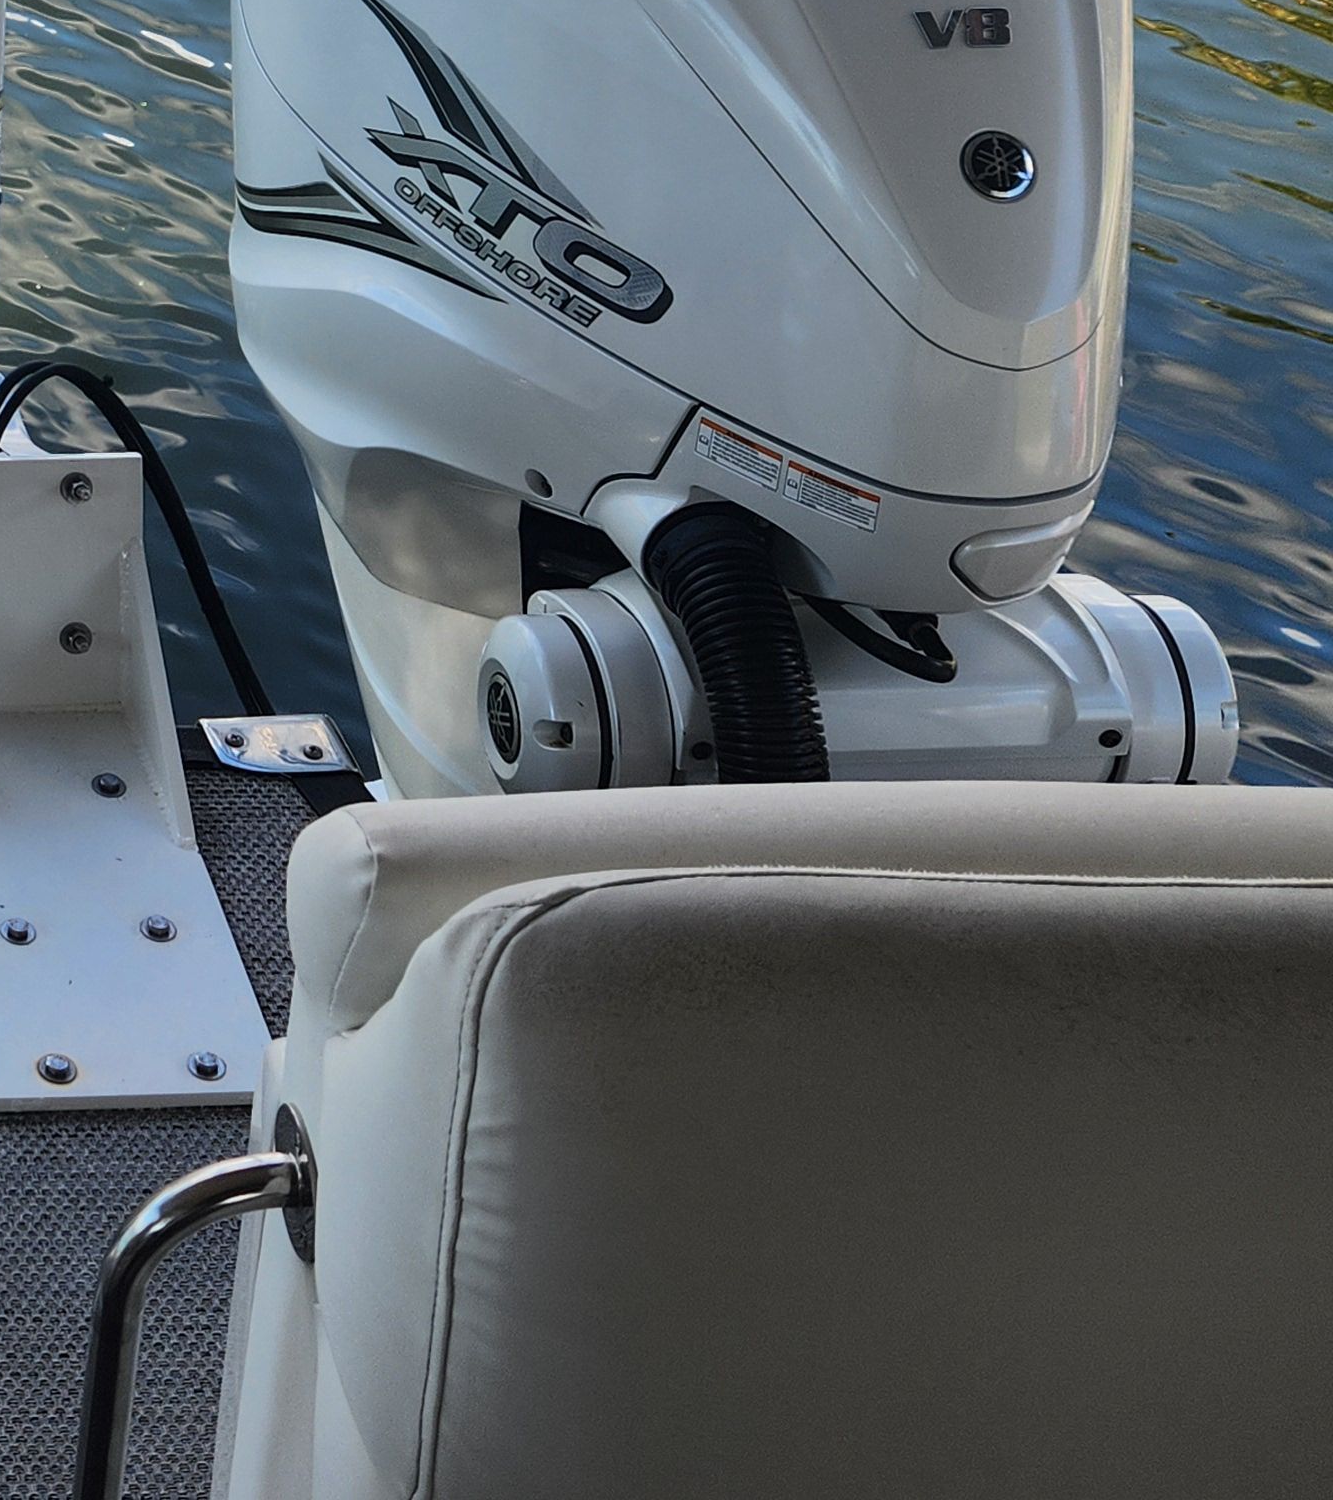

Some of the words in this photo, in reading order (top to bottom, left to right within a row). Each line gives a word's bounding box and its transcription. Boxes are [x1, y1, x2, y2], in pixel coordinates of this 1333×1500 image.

[913, 6, 1013, 49] V8
[363, 95, 674, 324] XTO
[394, 177, 603, 328] OFFSHORE
